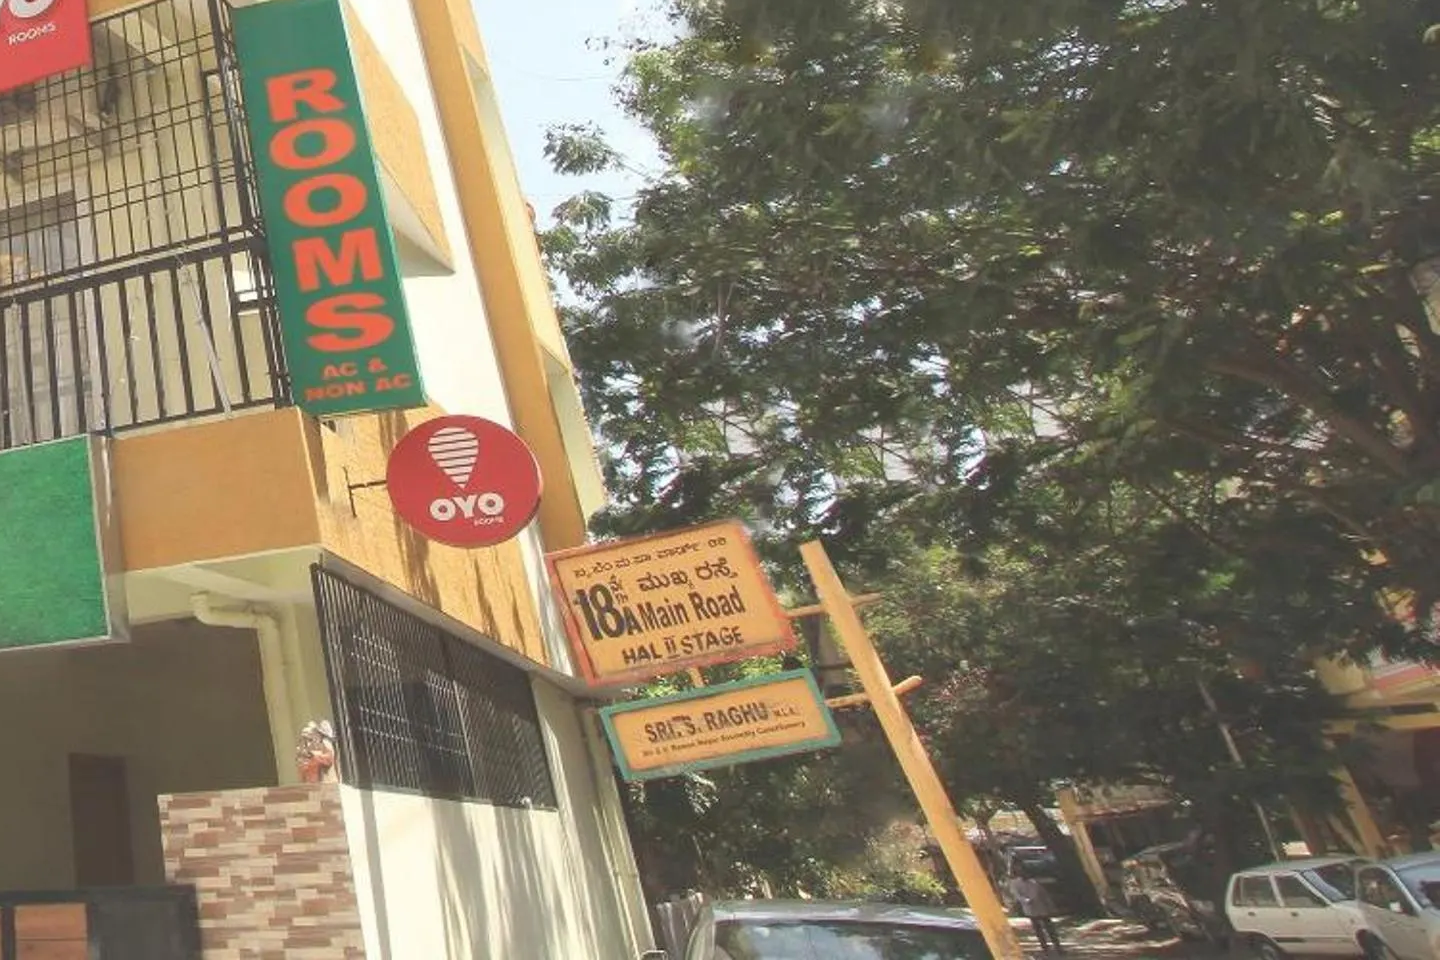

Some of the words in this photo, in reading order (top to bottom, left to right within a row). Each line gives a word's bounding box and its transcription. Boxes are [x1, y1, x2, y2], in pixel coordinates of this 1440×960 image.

[8, 22, 56, 46] ROOMS
[265, 68, 394, 352] ROOMS
[322, 361, 358, 379] AC
[368, 357, 387, 373] &
[376, 373, 412, 392] AC
[429, 493, 504, 521] OYO
[636, 597, 690, 630] Main
[688, 585, 746, 621] Road
[622, 641, 662, 664] HAL
[681, 626, 744, 655] STAGE
[703, 702, 769, 731] RAGHU
